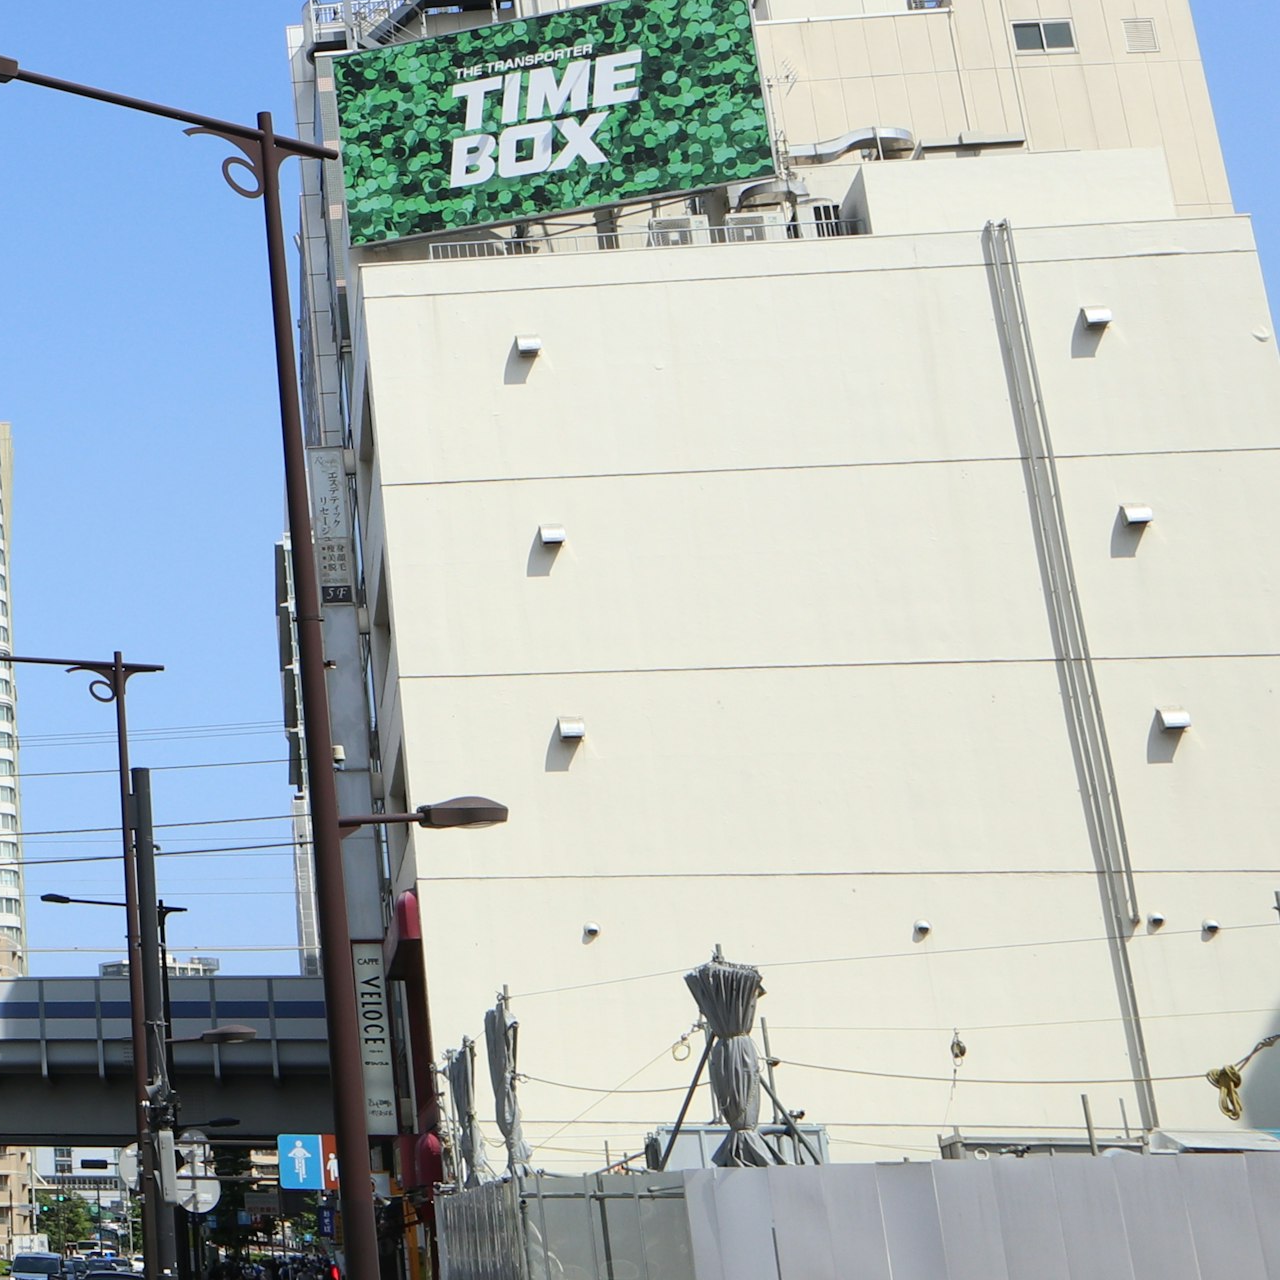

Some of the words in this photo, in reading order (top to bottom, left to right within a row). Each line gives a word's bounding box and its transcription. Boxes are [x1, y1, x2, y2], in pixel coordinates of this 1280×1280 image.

[452, 49, 642, 131] TIME
[455, 63, 482, 79] THE
[486, 43, 593, 73] TRANSPORTER
[450, 111, 610, 188] BOX
[361, 976, 386, 1045] VELOCE
